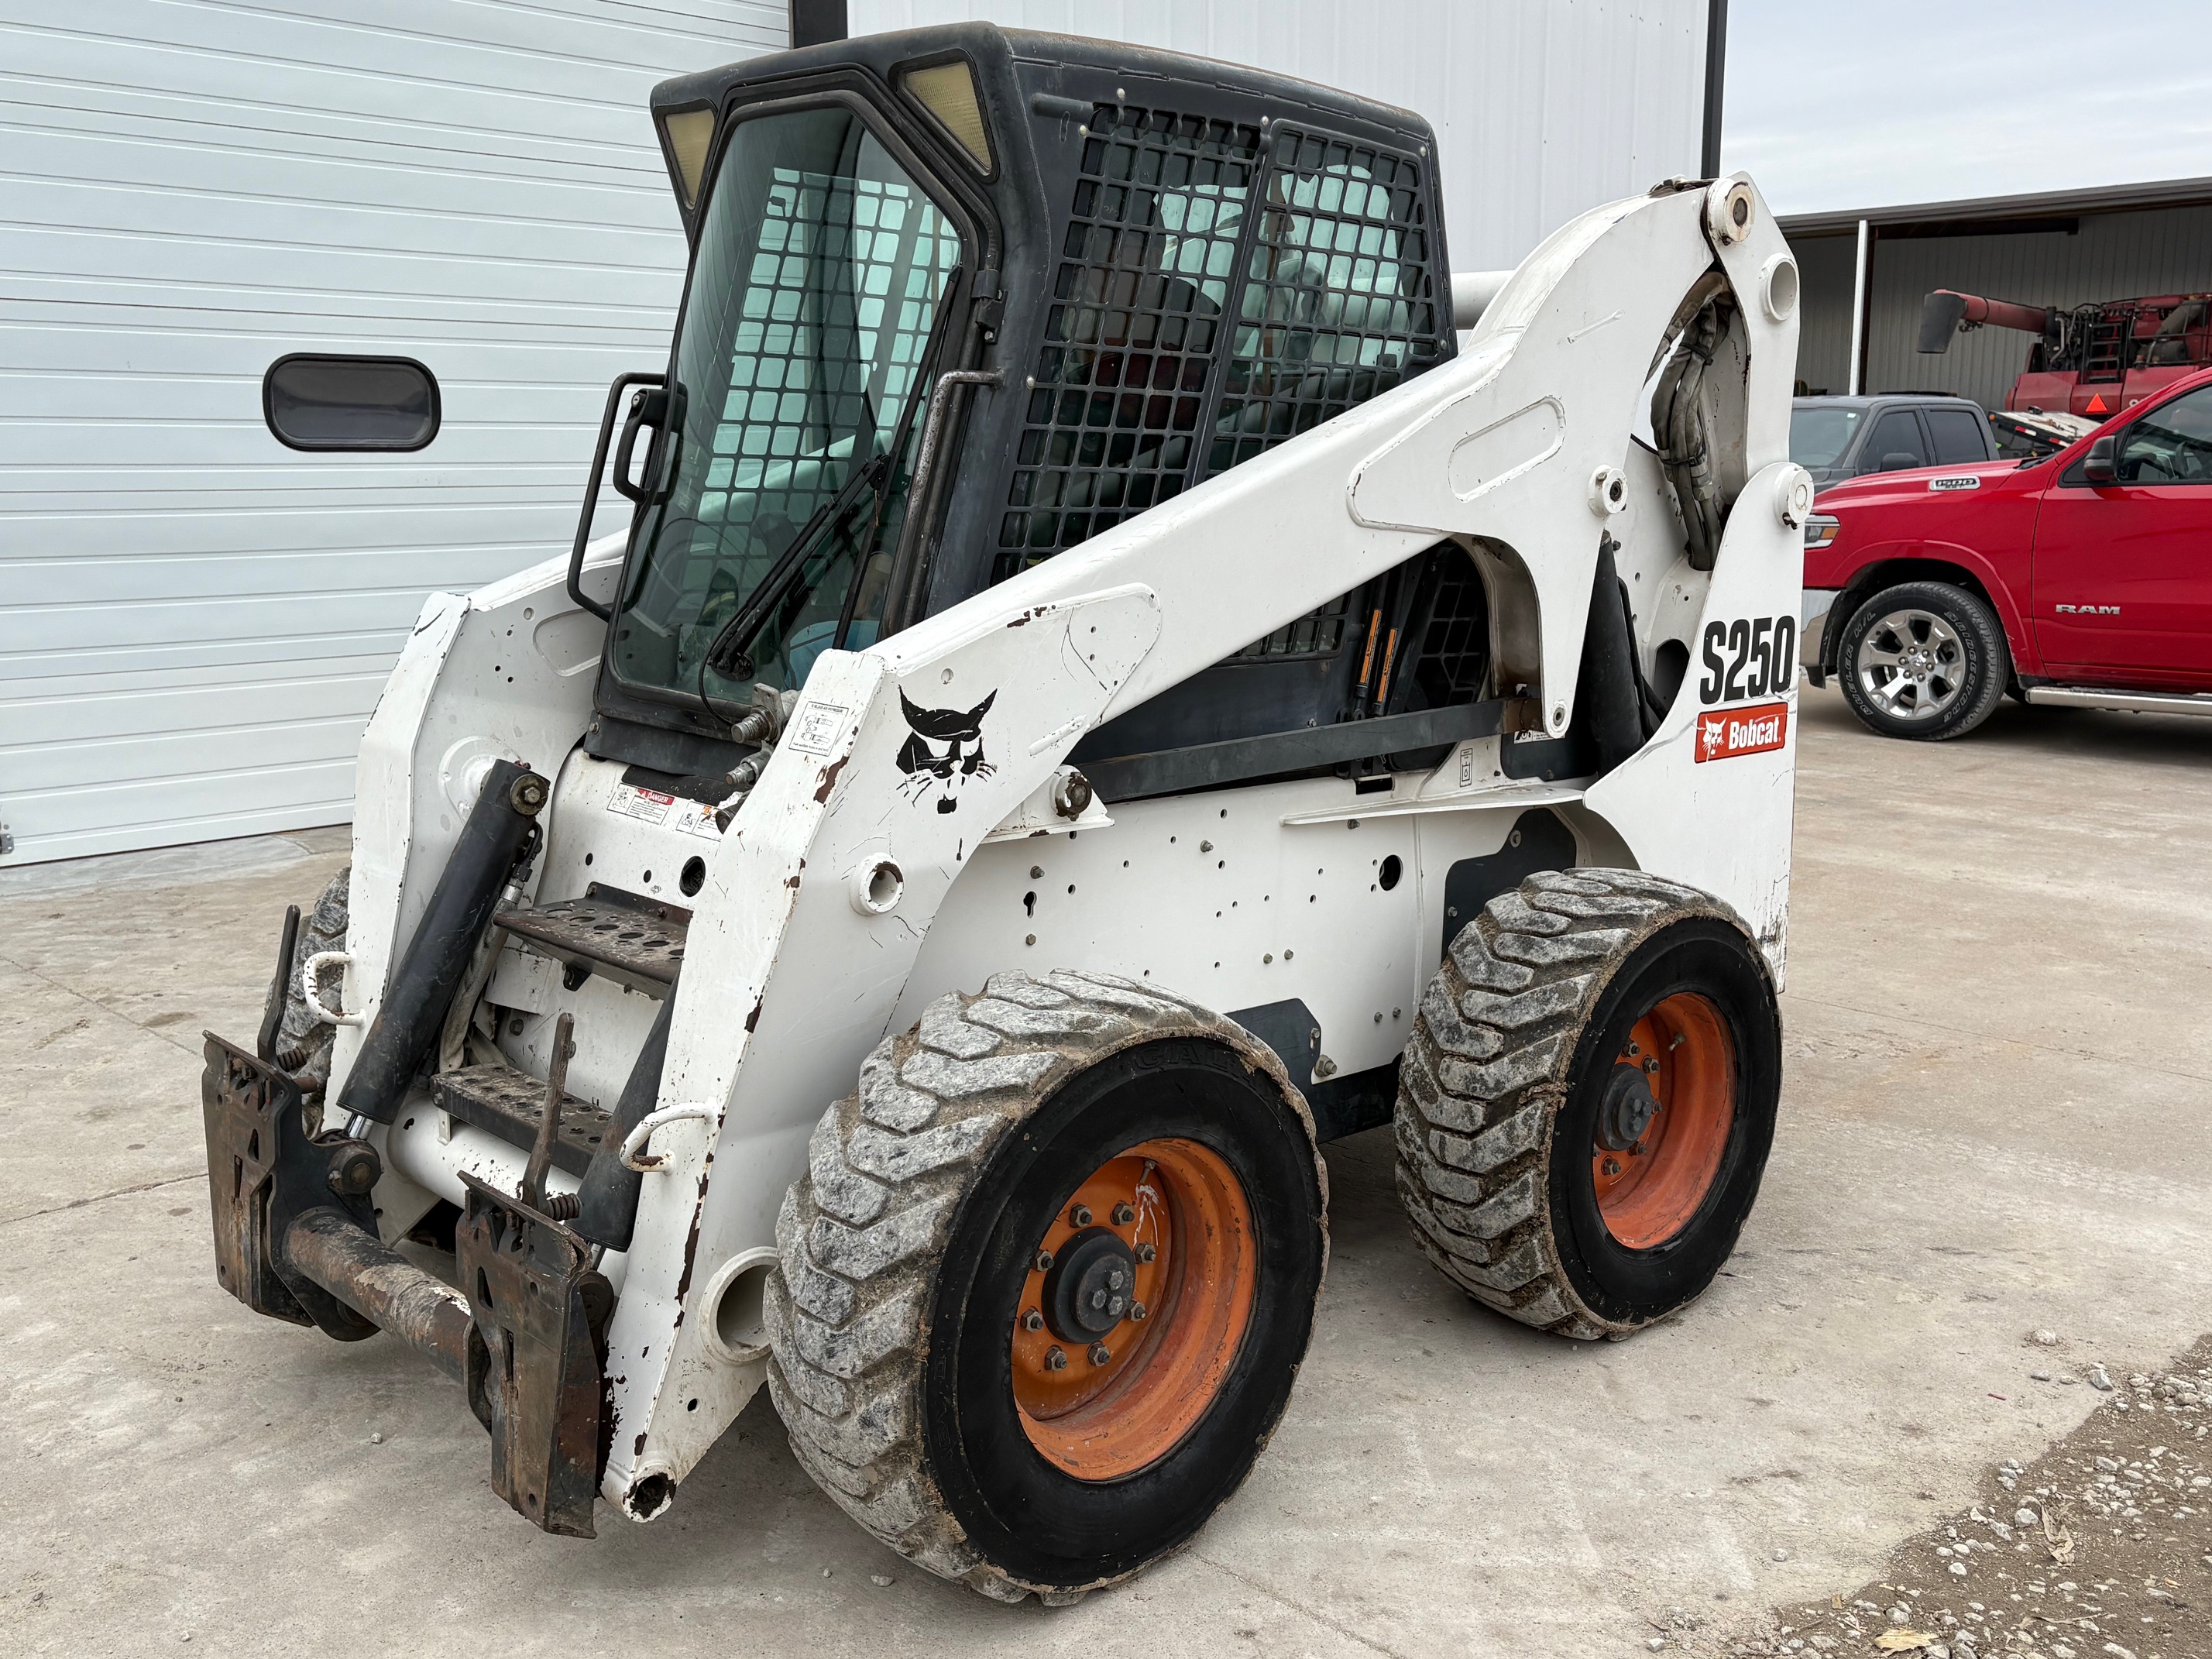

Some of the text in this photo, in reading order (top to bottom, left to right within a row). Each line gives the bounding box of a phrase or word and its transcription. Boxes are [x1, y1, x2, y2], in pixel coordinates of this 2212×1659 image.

[2056, 604, 2121, 615] RAM
[1700, 615, 1795, 705] S250
[1844, 645, 1873, 716] DUELER
[1943, 611, 1977, 723] BRIDGESTONE
[1728, 716, 1780, 750] Bobcat
[647, 792, 669, 802] DANGER
